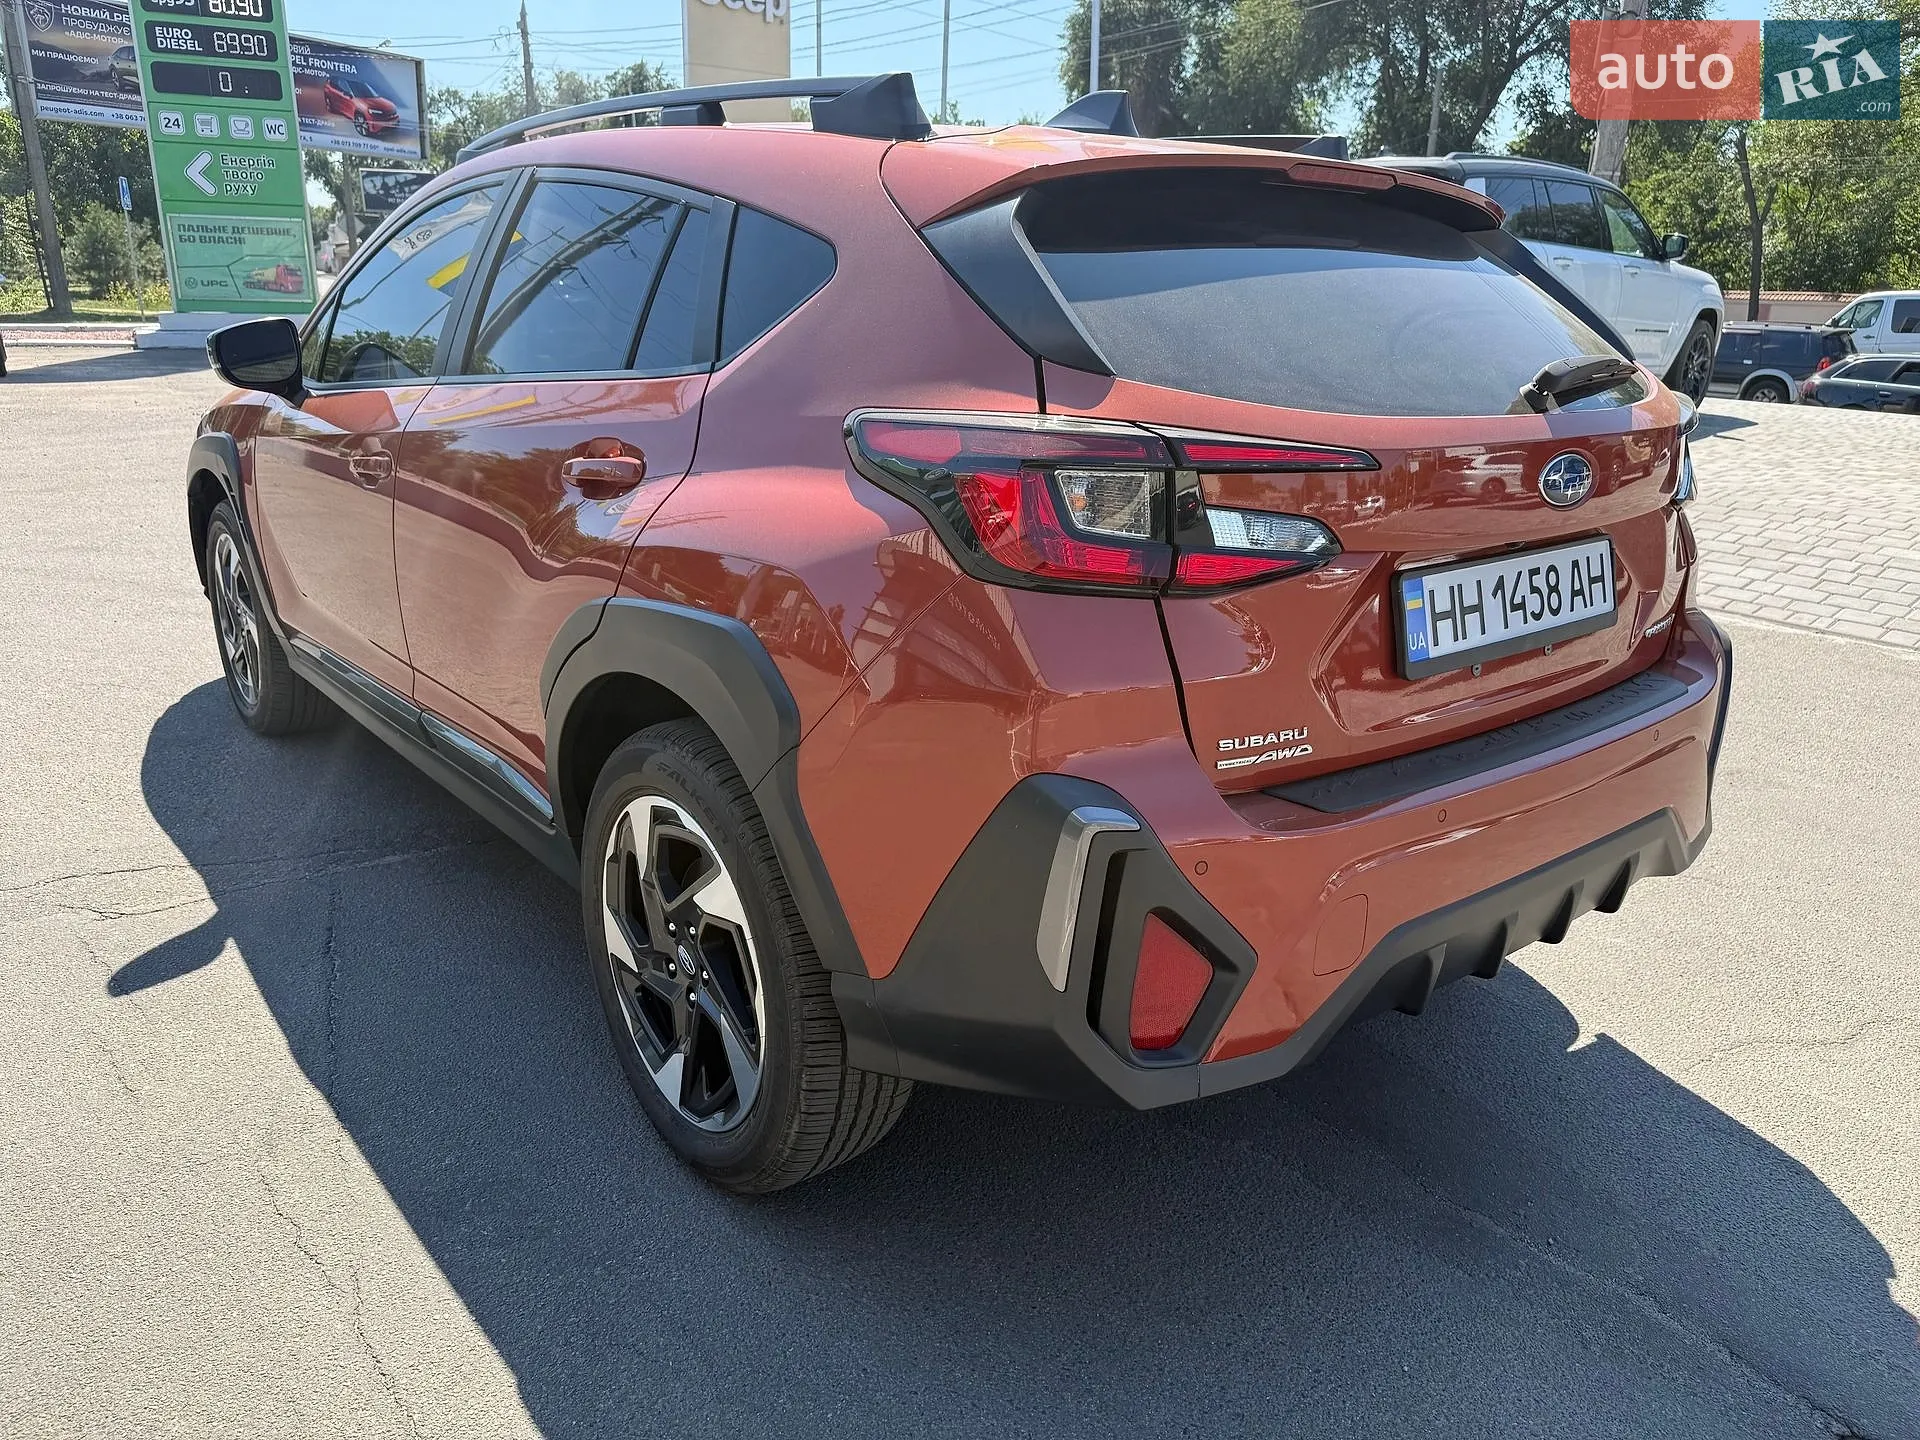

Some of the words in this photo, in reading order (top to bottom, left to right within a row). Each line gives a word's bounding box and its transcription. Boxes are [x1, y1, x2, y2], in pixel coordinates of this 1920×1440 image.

[61, 3, 110, 20] НОВИЙ
[62, 17, 131, 36] ПРОБУДЖУЄ
[155, 27, 192, 39] EURO
[157, 38, 203, 51] DIESEL
[214, 32, 268, 56] 69.90
[289, 44, 311, 55] ОВИЙ
[31, 49, 45, 57] МИ
[47, 51, 99, 64] ПРАЦЮЄМО!
[290, 54, 307, 66] PEL
[308, 57, 358, 75] FRONTERA
[89, 89, 101, 98] НА
[40, 104, 105, 118] peugeot-adis.com
[163, 117, 181, 130] 24
[266, 124, 285, 136] WC
[220, 154, 276, 169] Енергія
[223, 169, 264, 181] твого
[224, 182, 258, 196] руху
[177, 223, 229, 235] ПАЛЬНЕ
[231, 225, 297, 239] ДЕШЕВШЕ,
[178, 234, 196, 244] БО
[1428, 578, 1487, 647] HH
[1491, 563, 1562, 630] 1458
[1569, 552, 1608, 613] AH
[1408, 633, 1427, 650] UA
[1217, 726, 1309, 752] SUBARU
[1254, 744, 1313, 765] AWD
